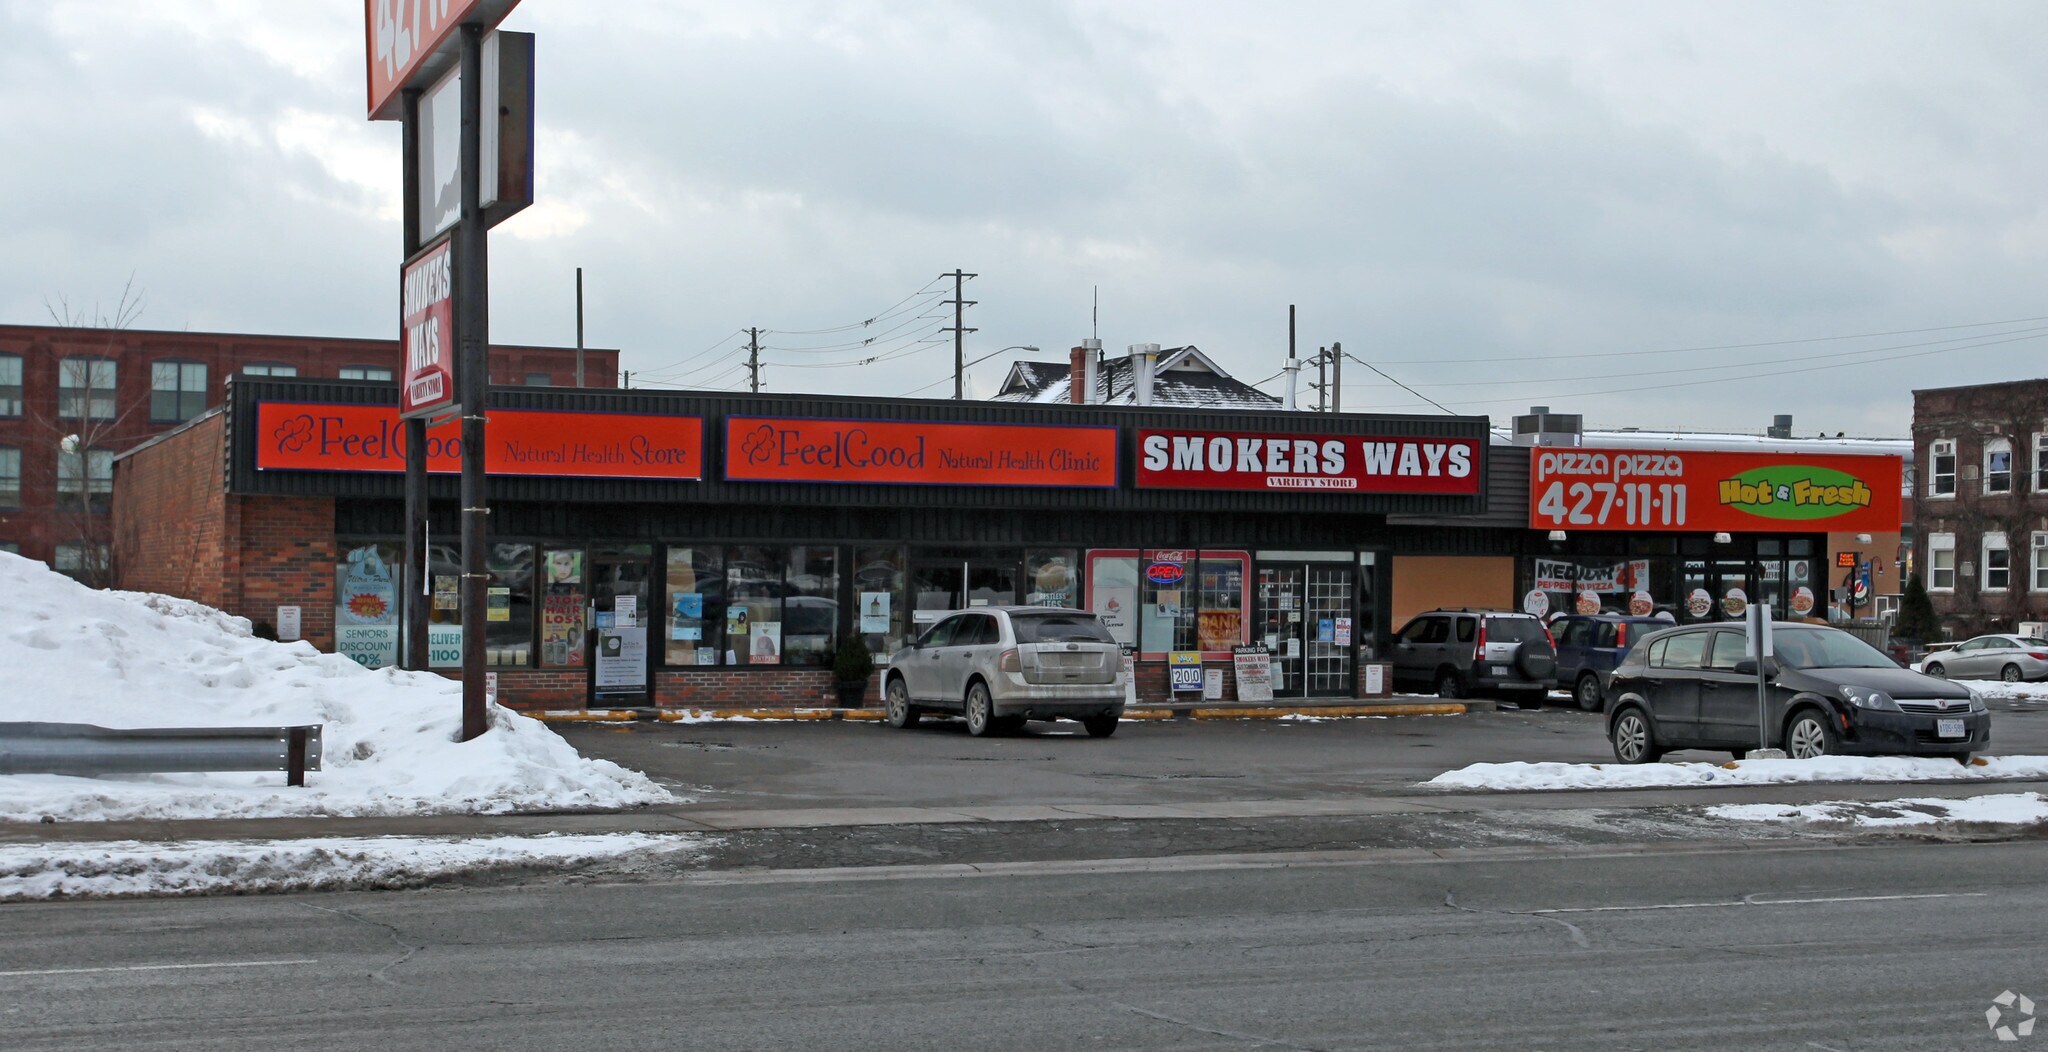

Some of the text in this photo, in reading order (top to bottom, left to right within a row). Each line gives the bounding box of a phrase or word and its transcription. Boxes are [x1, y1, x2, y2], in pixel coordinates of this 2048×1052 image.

[404, 250, 450, 320] SMOKERS
[410, 316, 439, 371] WAYS
[504, 440, 566, 463] Natural
[571, 442, 625, 464] Health
[629, 434, 687, 465] Store
[778, 429, 1100, 471] FeelGood Natural Health Clinic
[1143, 435, 1471, 478] SMOKERS WAYS
[1269, 477, 1355, 487] VARIETY STORE
[1718, 479, 1774, 505] Hot
[1792, 478, 1872, 508] Fresh
[1147, 565, 1184, 578] OPEN
[1537, 562, 1614, 581] MEDIUM
[1587, 582, 1614, 590] PIZZA
[546, 596, 581, 604] STOP
[546, 606, 580, 614] HAIR
[545, 615, 581, 624] LOSS
[1200, 615, 1240, 628] BANK
[346, 629, 388, 639] SENIORS
[428, 633, 461, 645] ELIVER
[340, 641, 392, 651] DISCOUNT
